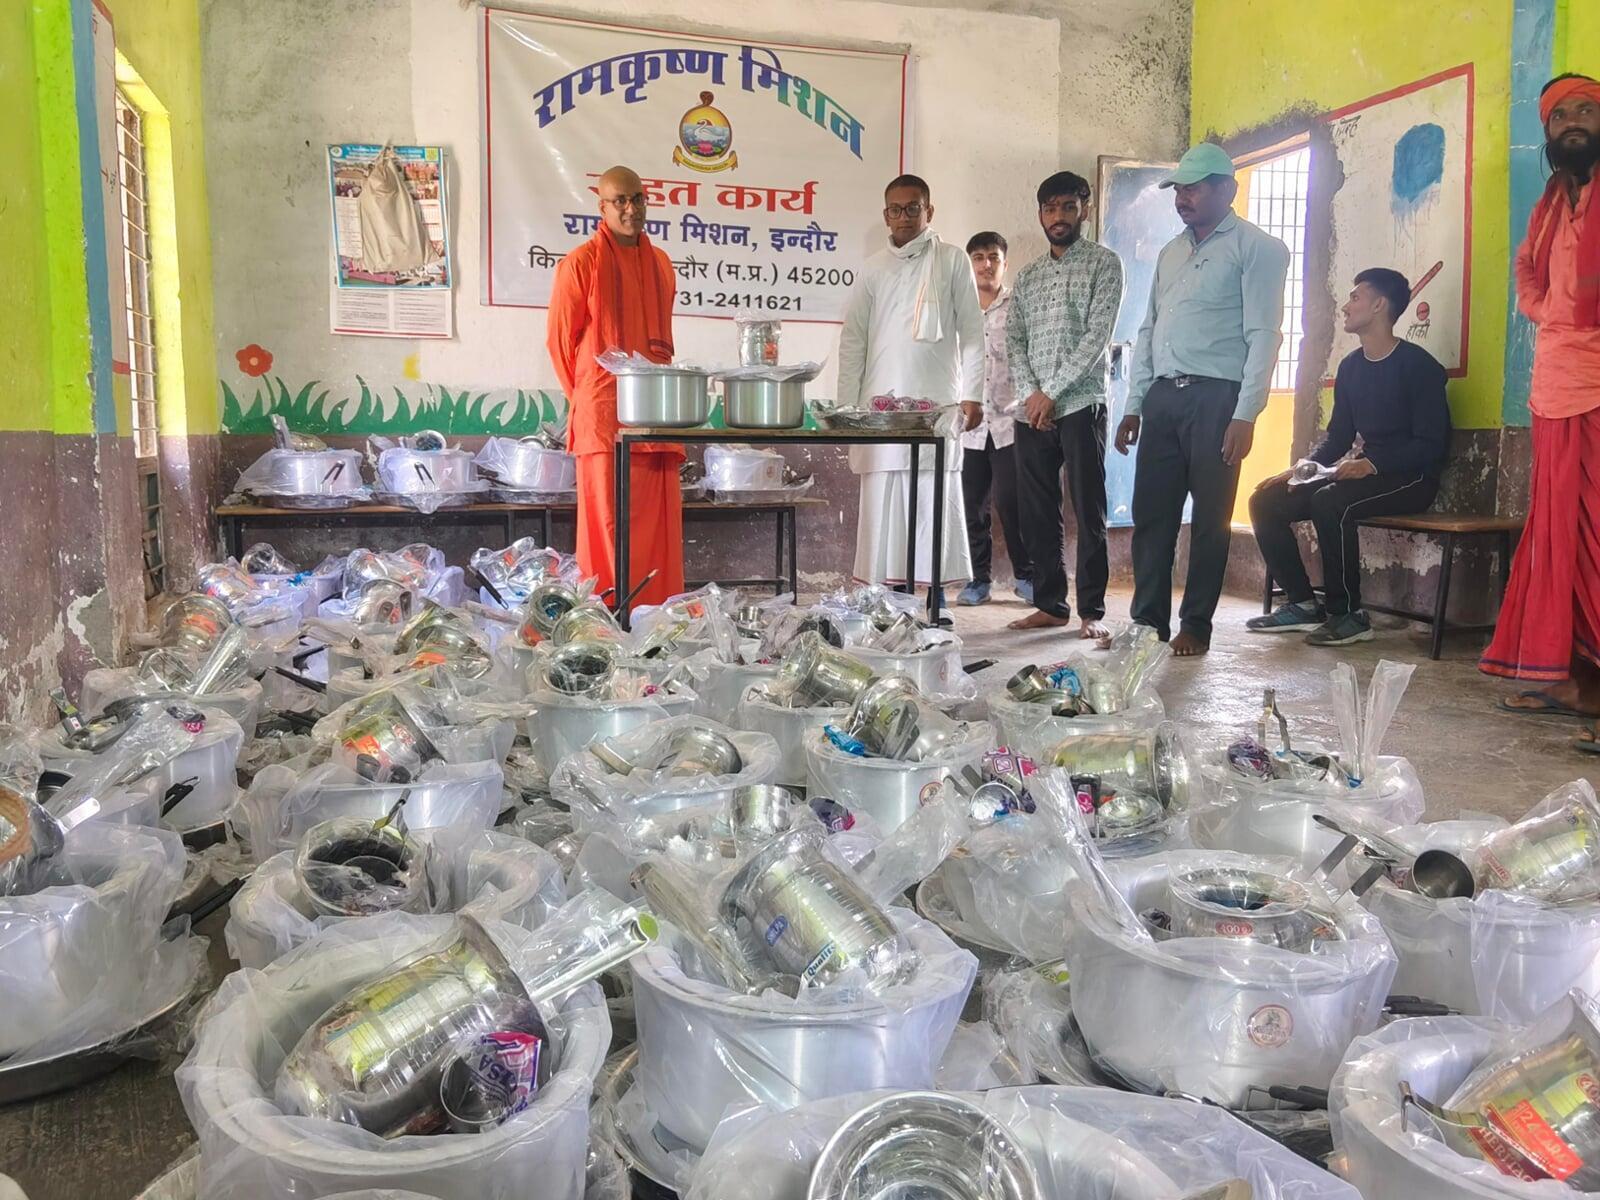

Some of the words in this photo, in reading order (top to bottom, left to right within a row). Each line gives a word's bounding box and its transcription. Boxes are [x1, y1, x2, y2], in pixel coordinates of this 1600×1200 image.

[533, 49, 728, 128] रामकृष्ण
[738, 45, 865, 161] मिशन
[715, 181, 819, 215] कार्य
[680, 213, 758, 252] मिशन,
[769, 221, 838, 253] इन्दौर
[716, 260, 778, 286] (म.प्र.)
[787, 266, 859, 287] 45200
[675, 290, 802, 311] 31-2411621
